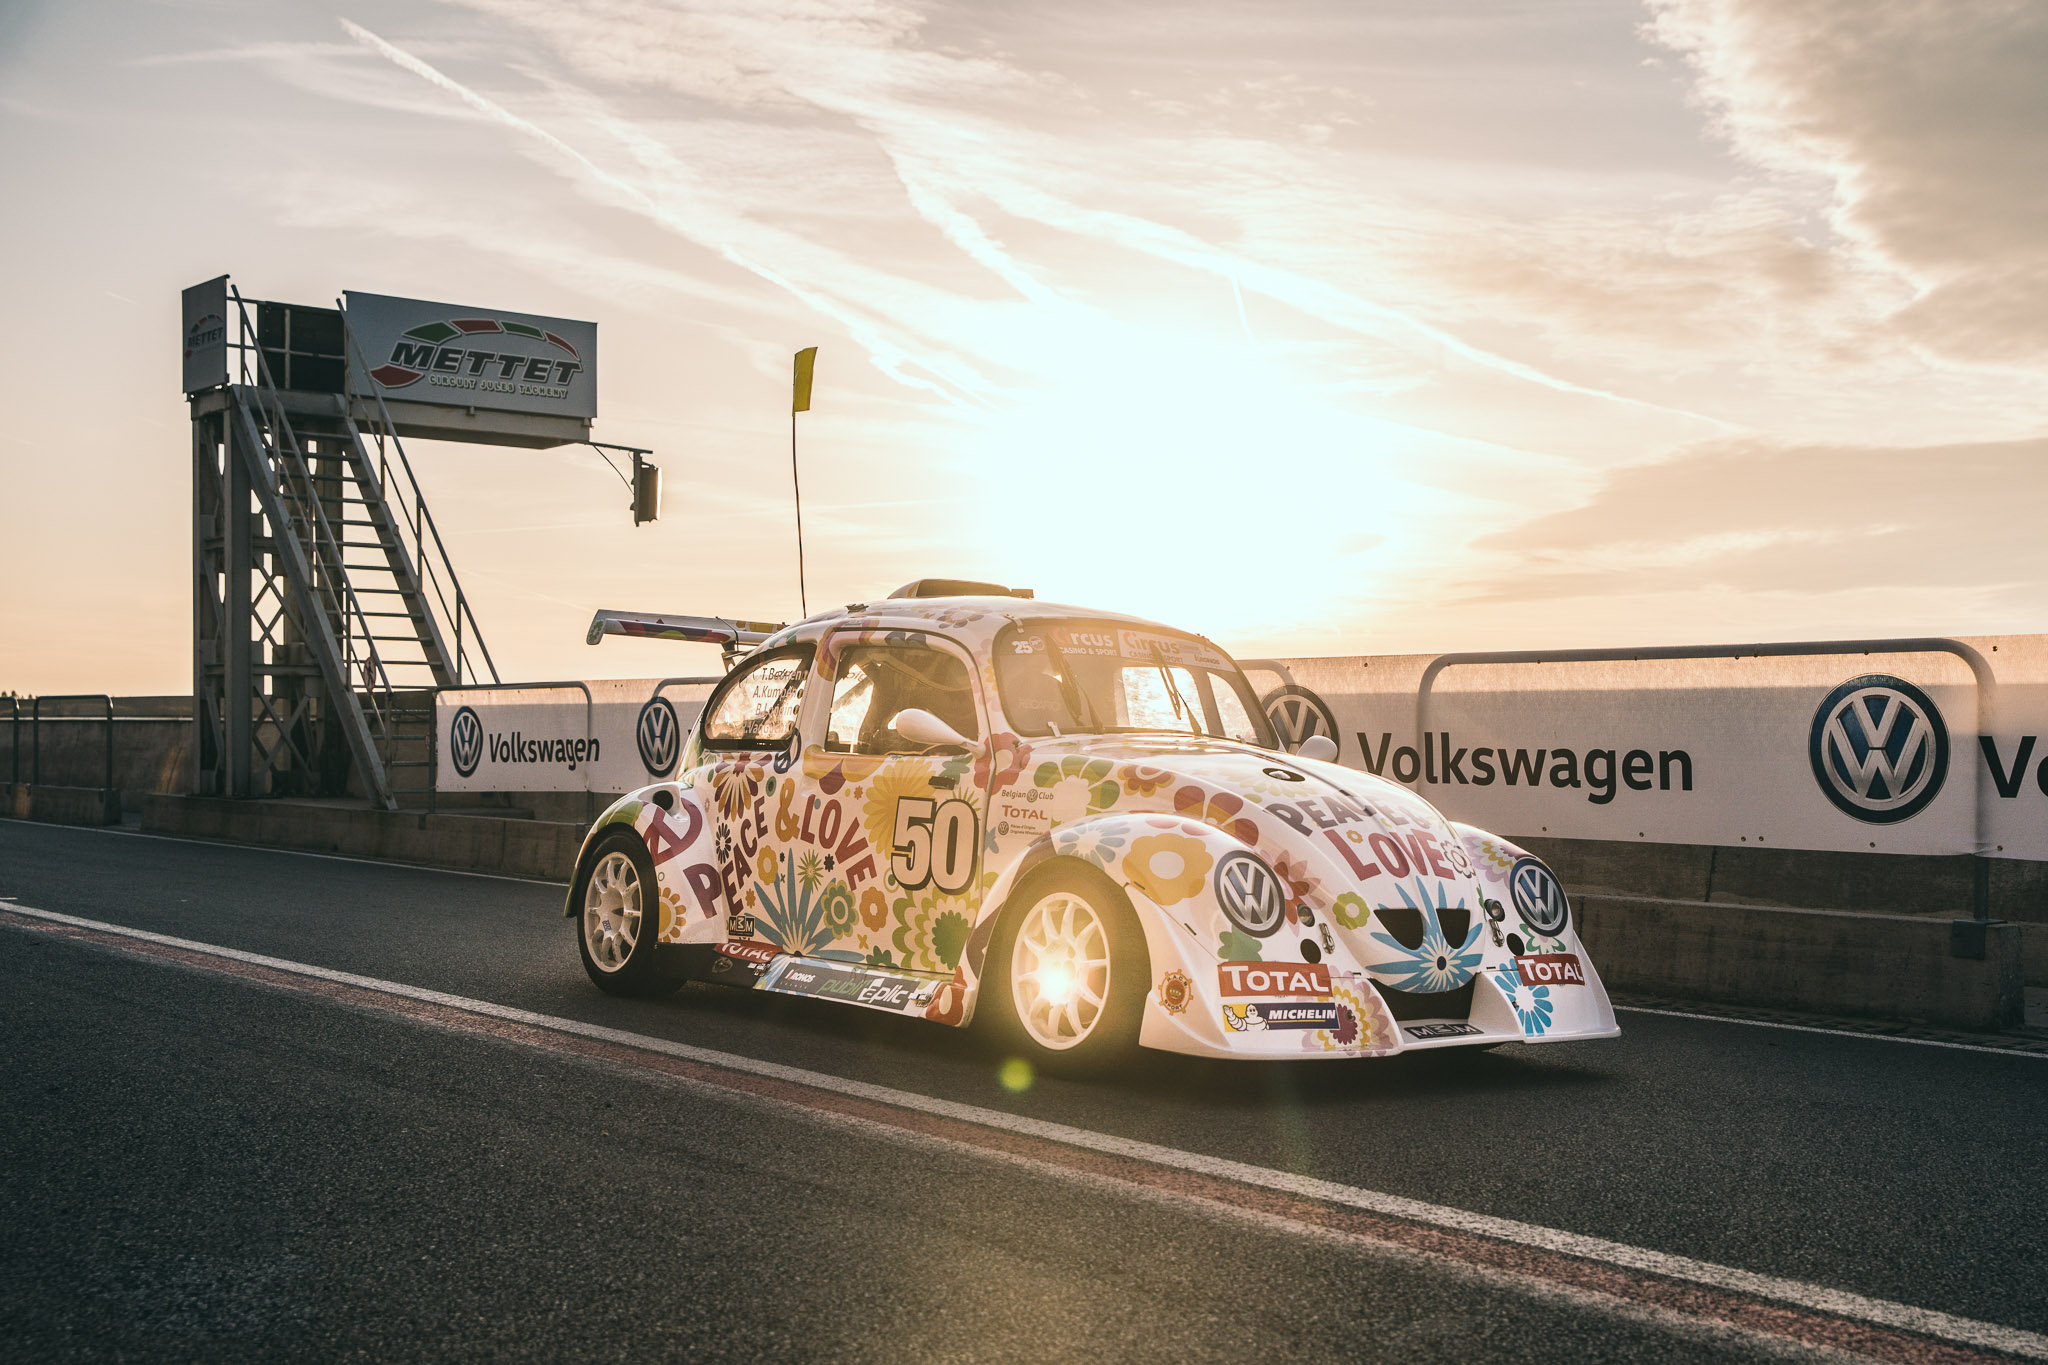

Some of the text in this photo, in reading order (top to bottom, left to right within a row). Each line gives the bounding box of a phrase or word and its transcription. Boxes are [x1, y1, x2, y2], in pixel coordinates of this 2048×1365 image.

[188, 327, 223, 348] METTET
[389, 342, 582, 385] METTET
[430, 375, 568, 399] CIRCUIT JULES TACHENY
[1012, 640, 1033, 654] 25
[1096, 648, 1118, 656] SPORT
[489, 732, 600, 770] Volkswagen
[1357, 732, 1693, 804] Volkswagen
[1002, 790, 1026, 800] Belgian
[1039, 791, 1054, 800] Club
[1002, 805, 1048, 820] TOTAL
[1263, 796, 1409, 837] PEACE
[683, 778, 877, 919] PEACE & LOVE
[891, 795, 979, 895] 50
[1323, 829, 1456, 881] LOVE
[1222, 965, 1329, 992] TOTAL
[1518, 959, 1584, 982] TOTAL
[1268, 1009, 1336, 1020] MICHELIN
